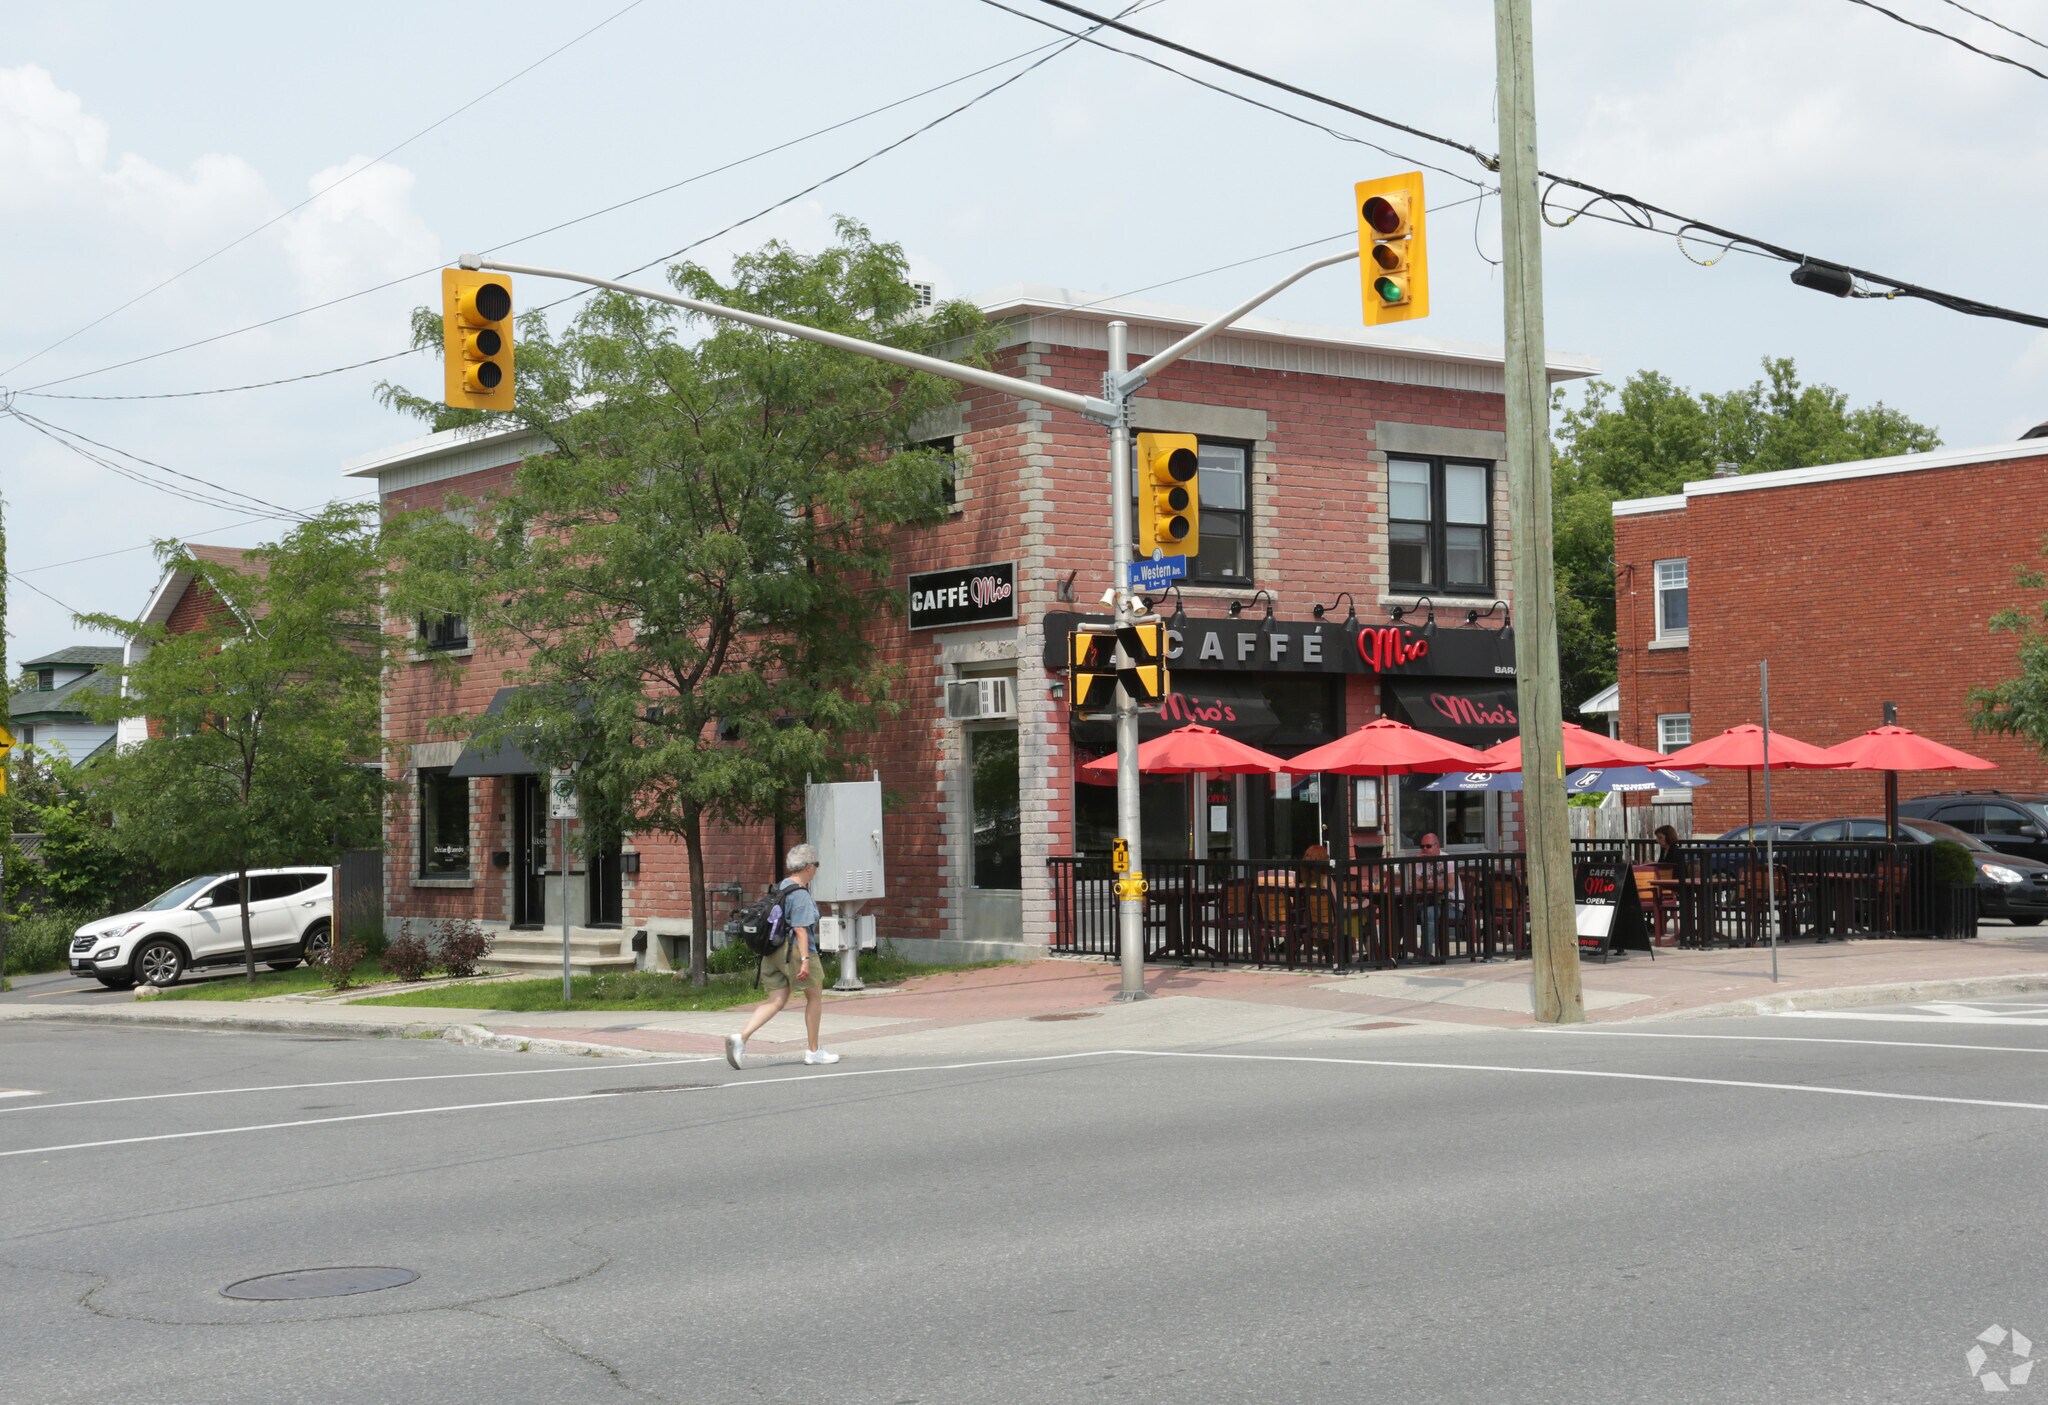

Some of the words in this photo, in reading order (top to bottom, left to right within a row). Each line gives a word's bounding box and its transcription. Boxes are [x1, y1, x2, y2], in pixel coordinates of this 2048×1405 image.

[1141, 564, 1171, 580] Western
[912, 581, 969, 612] CAFFÉ
[970, 576, 1012, 608] Mio
[1166, 626, 1323, 663] CAFFÉ
[1357, 627, 1429, 673] Mio
[1430, 692, 1518, 725] Mio's
[1207, 794, 1229, 803] OPEN
[1590, 867, 1616, 877] CAFFÉ
[1584, 877, 1615, 895] Mio
[1585, 897, 1606, 905] OPEN
